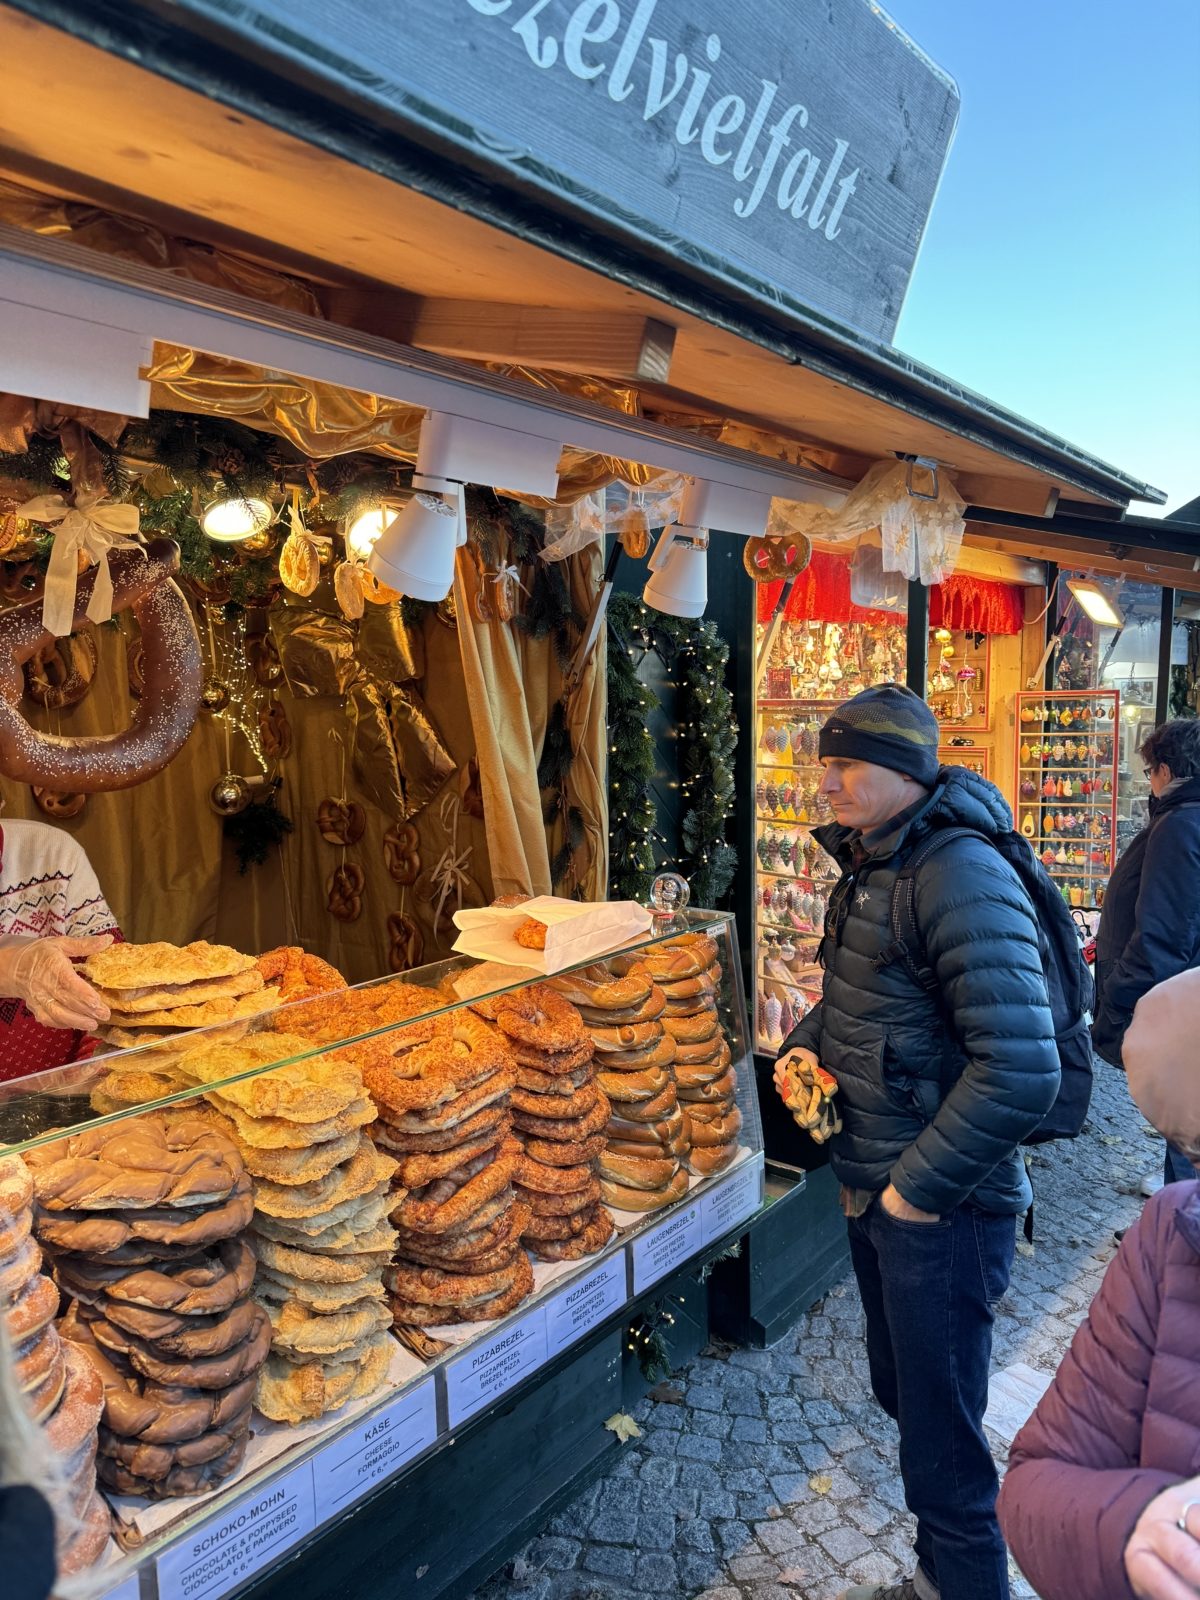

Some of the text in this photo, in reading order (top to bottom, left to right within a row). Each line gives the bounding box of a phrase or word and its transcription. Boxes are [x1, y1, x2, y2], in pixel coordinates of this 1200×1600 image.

[466, 0, 860, 240] zelvielfalt
[647, 1216, 689, 1249] LAUGENBREZEL
[565, 1271, 608, 1306] PIZZABREZEL
[571, 1290, 605, 1318] PIZZAPRETZEL
[572, 1297, 605, 1325] BREZEL PIZZA
[472, 1329, 525, 1369] PIZZABREZEL
[479, 1350, 521, 1381] PIZZAPRETZEL
[480, 1358, 520, 1390] BREZEL PIZZA
[364, 1417, 390, 1442] KÄSE
[357, 1441, 400, 1476] FORMAGGIO
[364, 1436, 392, 1460] CHEESE
[193, 1489, 285, 1557] SCHOKO-MOHN
[181, 1503, 298, 1586] CHOCOLATE & POPPYSEED
[183, 1514, 296, 1596] CIOCCOLATO E PAPAVERO
